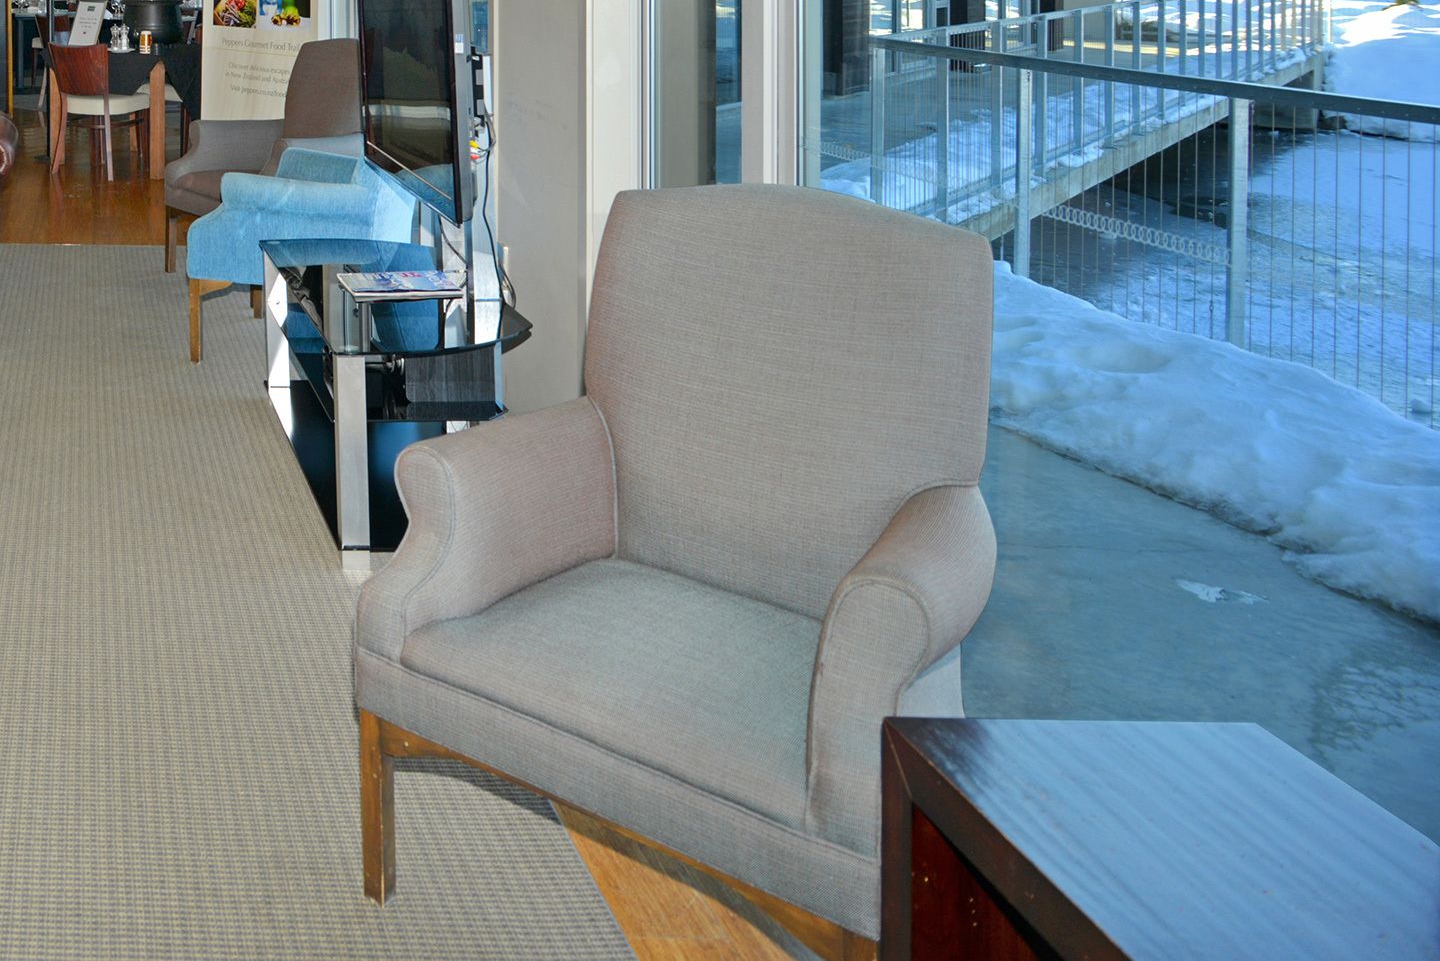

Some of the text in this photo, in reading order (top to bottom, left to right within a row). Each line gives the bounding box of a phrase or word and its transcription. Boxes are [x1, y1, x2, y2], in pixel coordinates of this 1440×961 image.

[222, 37, 244, 48] Peppers
[244, 39, 270, 49] Gourmet
[270, 42, 286, 51] Food
